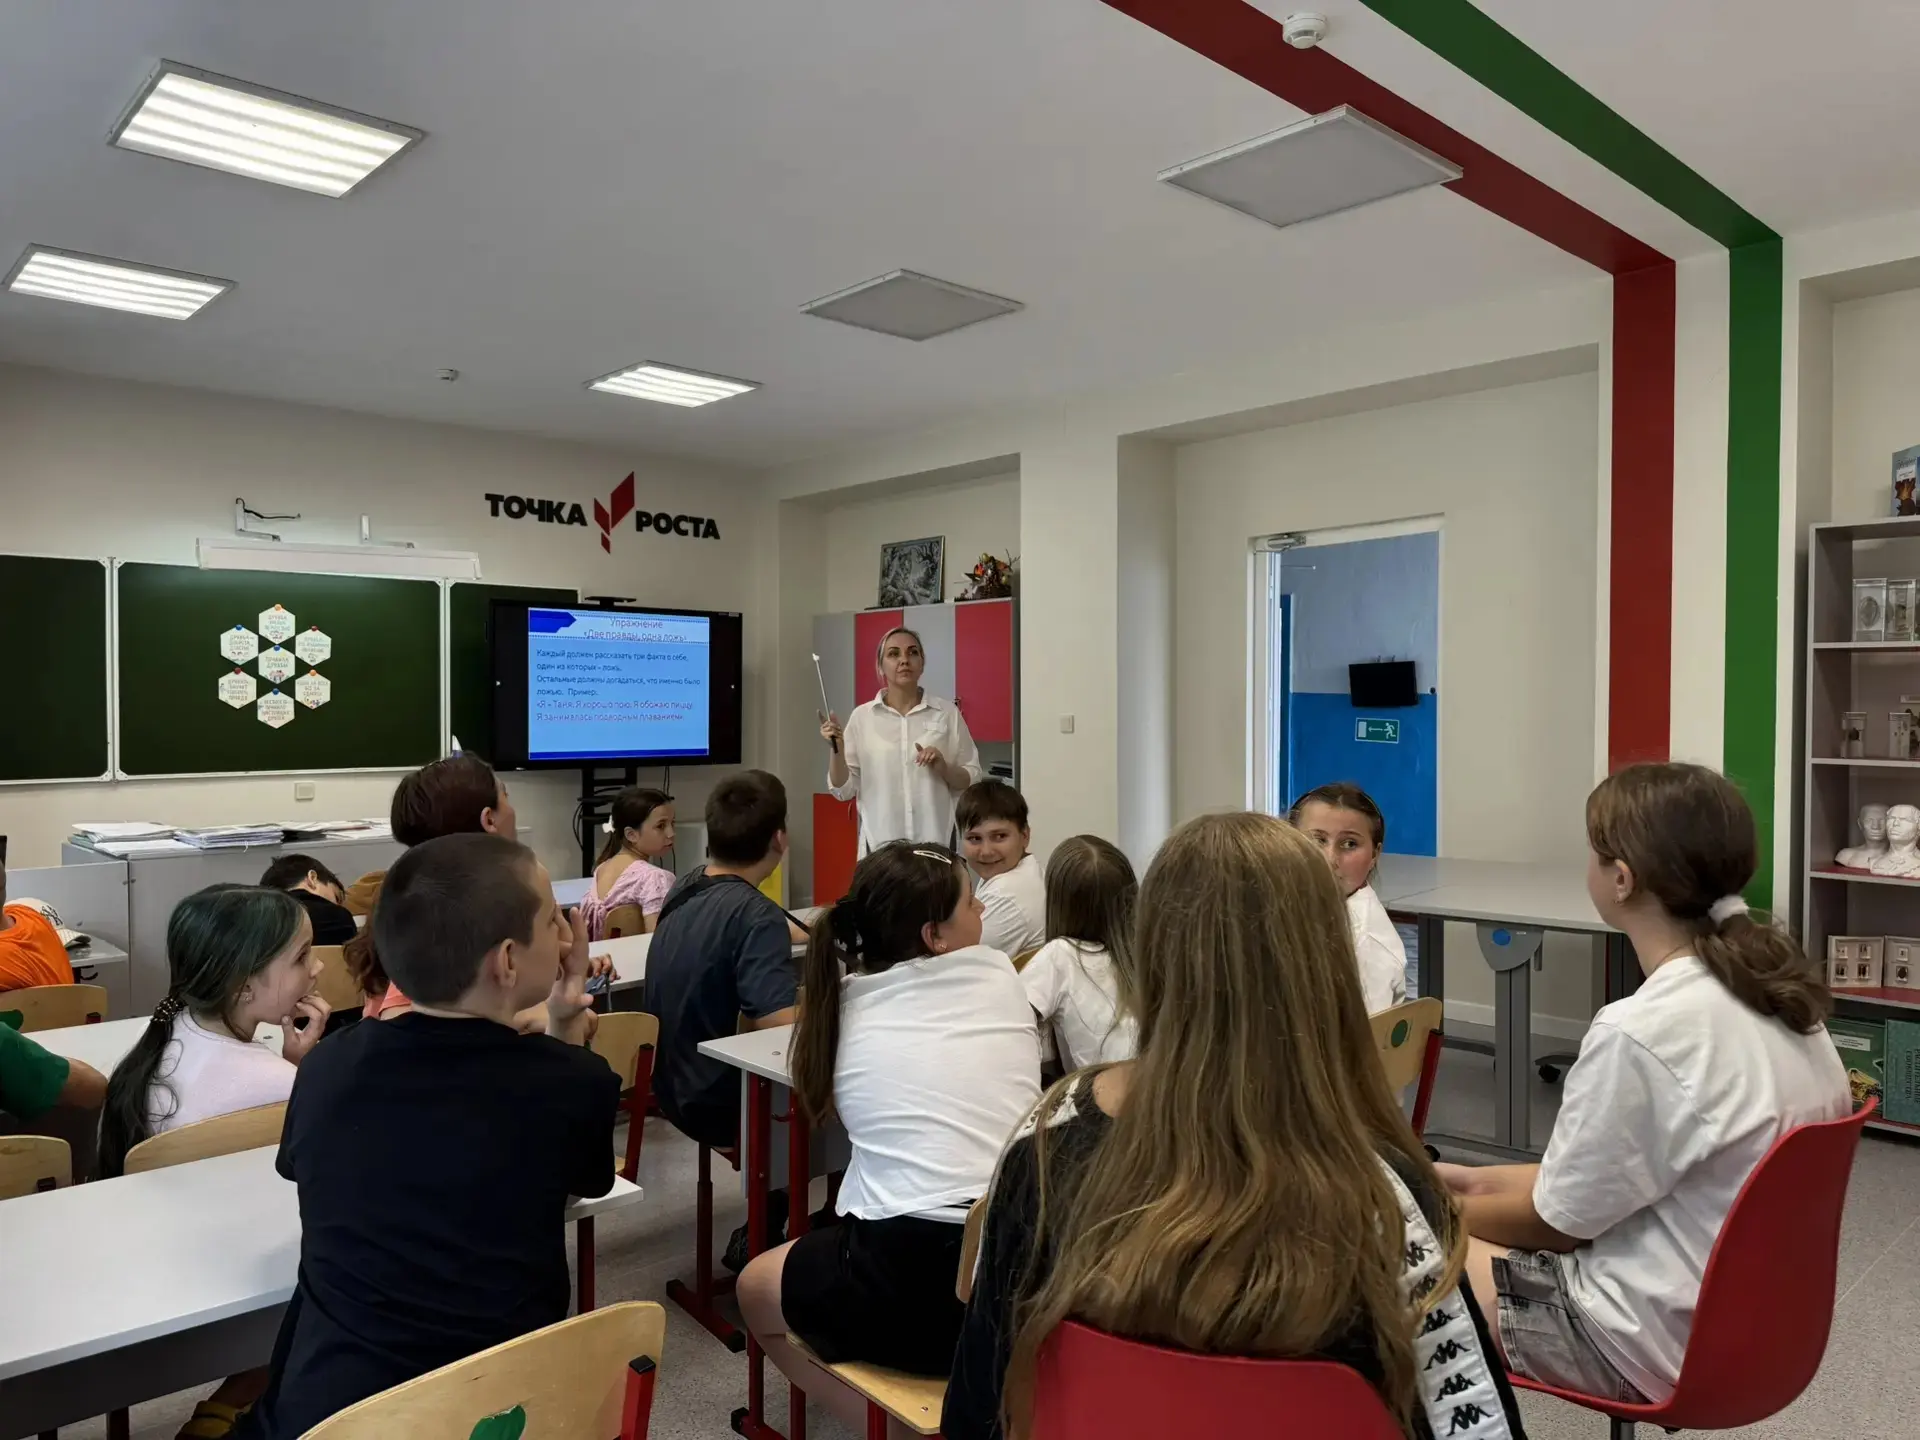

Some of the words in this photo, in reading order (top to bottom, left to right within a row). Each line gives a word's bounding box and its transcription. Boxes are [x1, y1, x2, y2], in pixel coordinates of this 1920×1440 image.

[485, 493, 588, 526] ТОЧКА
[636, 511, 720, 539] РОСТА
[610, 618, 664, 629] Упражнение
[536, 649, 566, 658] Каждый
[567, 651, 594, 660] должен
[595, 652, 632, 660] рассказать
[634, 653, 646, 661] три
[647, 652, 666, 661] факта
[536, 663, 556, 671] один
[567, 664, 597, 672] которых
[536, 675, 577, 683] Остальные
[684, 677, 701, 685] было
[575, 700, 582, 708] Я
[583, 701, 613, 710] хорошо
[633, 701, 639, 709] Я
[640, 700, 670, 709] обожаю
[536, 712, 543, 721] Я
[594, 714, 638, 722] подводным
